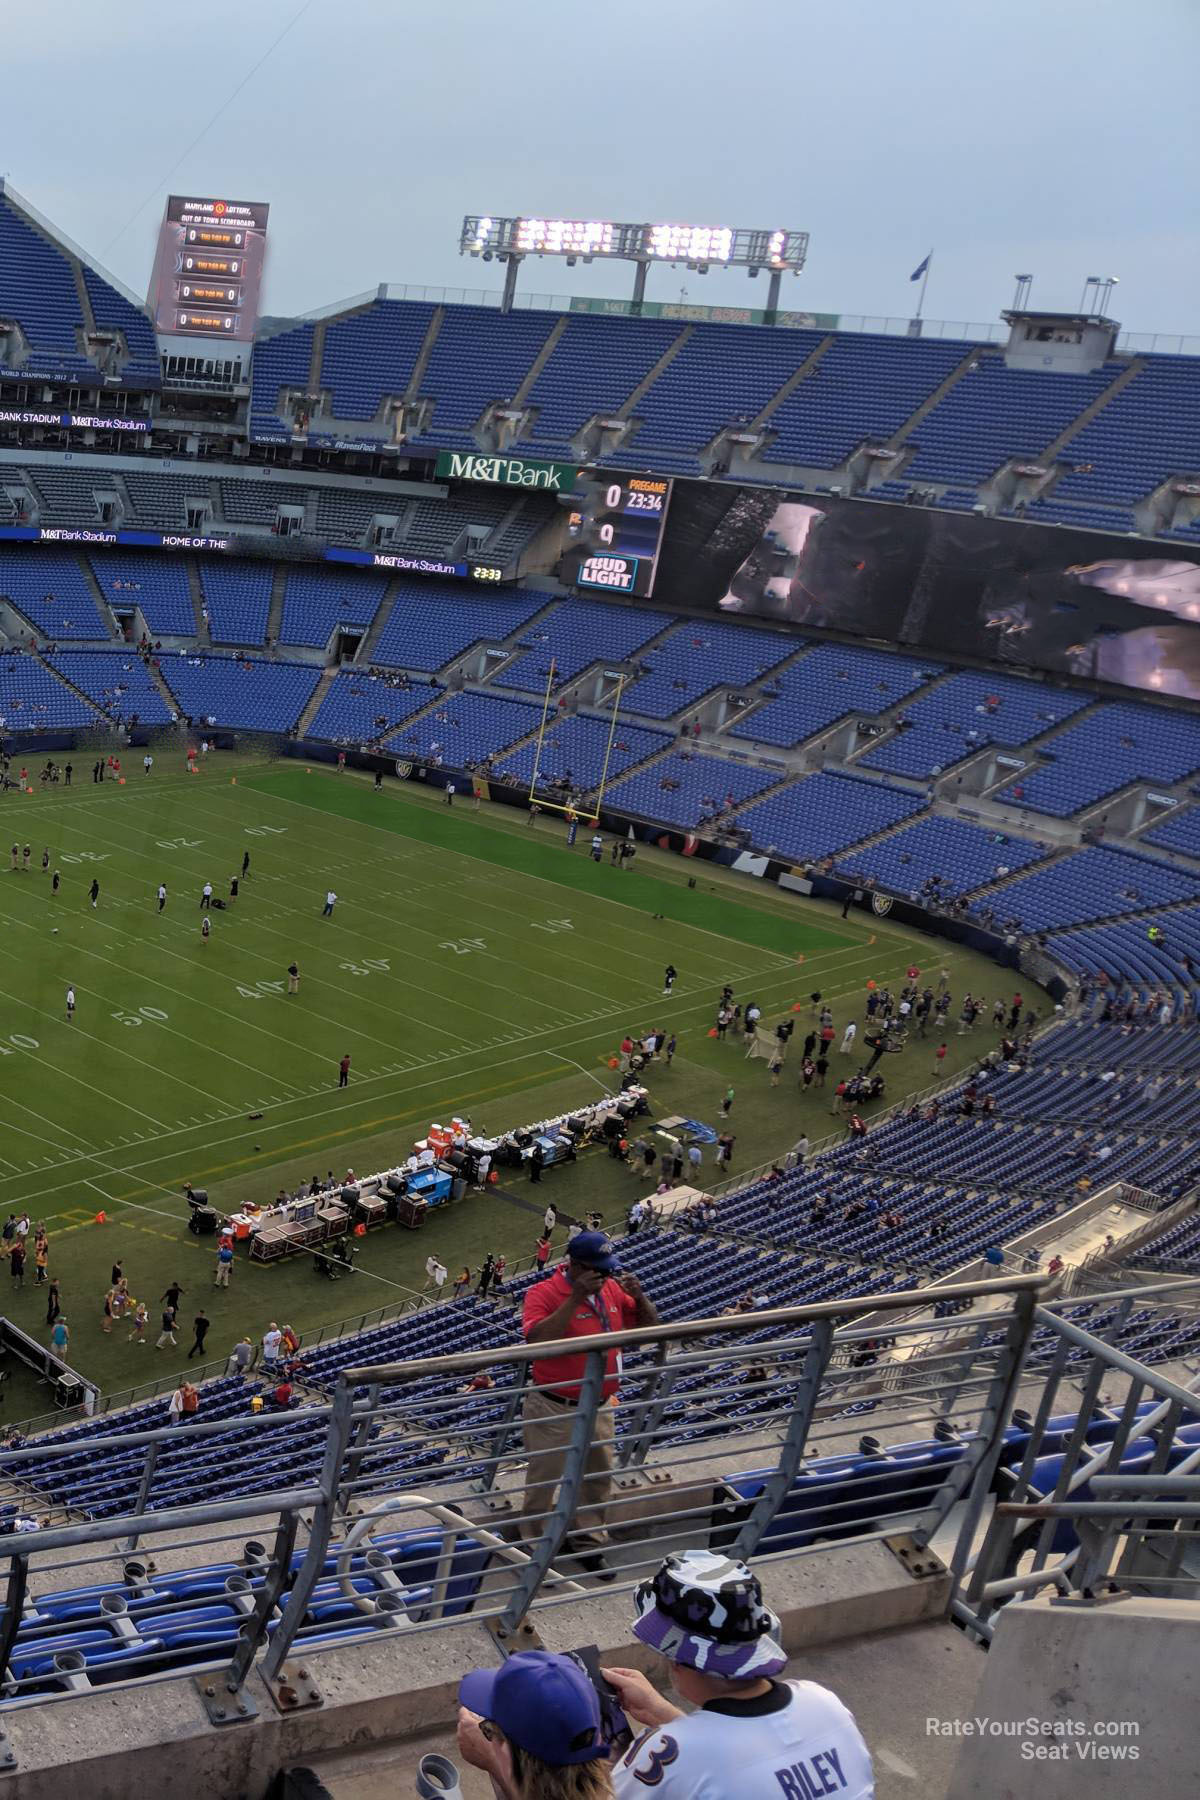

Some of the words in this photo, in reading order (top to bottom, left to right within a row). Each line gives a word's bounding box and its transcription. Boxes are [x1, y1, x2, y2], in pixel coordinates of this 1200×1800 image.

[185, 202, 214, 212] MARYLAND
[203, 216, 219, 224] TOWN
[220, 218, 255, 227] SCOREBOARD
[189, 230, 196, 240] 0
[235, 234, 241, 244] 0
[187, 258, 193, 269] 0
[231, 262, 238, 272] 0
[183, 286, 190, 297] 0
[228, 290, 235, 300] 0
[180, 314, 187, 325] 0
[224, 318, 231, 328] 0
[21, 371, 51, 379] CHAMPIONS
[23, 413, 60, 424] STADIUM
[71, 416, 93, 426] M&T
[93, 418, 112, 428] Bank
[113, 418, 146, 430] Stadium
[335, 441, 377, 452] #RavensFlock
[448, 454, 507, 481] M&T
[506, 461, 561, 489] Bank
[629, 479, 668, 493] PREGAME
[606, 484, 621, 507] 0
[627, 493, 662, 511] 23:34
[41, 529, 62, 539] M&T
[62, 530, 82, 541] Bank
[82, 531, 116, 542] Stadium
[162, 536, 190, 546] HOME
[193, 538, 206, 548] OF
[208, 539, 226, 549] THE
[374, 554, 398, 566] M&T
[398, 557, 419, 569] Bank
[420, 560, 455, 574] Stadium
[585, 557, 627, 573] BUD
[473, 567, 502, 580] 23:33
[581, 567, 632, 588] LIGHT
[487, 649, 510, 658] GEICO
[155, 837, 193, 850] 20
[60, 850, 98, 864] 30
[530, 919, 567, 934] 10
[438, 939, 483, 954] 20
[339, 959, 385, 976] 30
[236, 980, 280, 1000] 40
[111, 1006, 169, 1027] 50
[774, 1747, 848, 1800] RILEY
